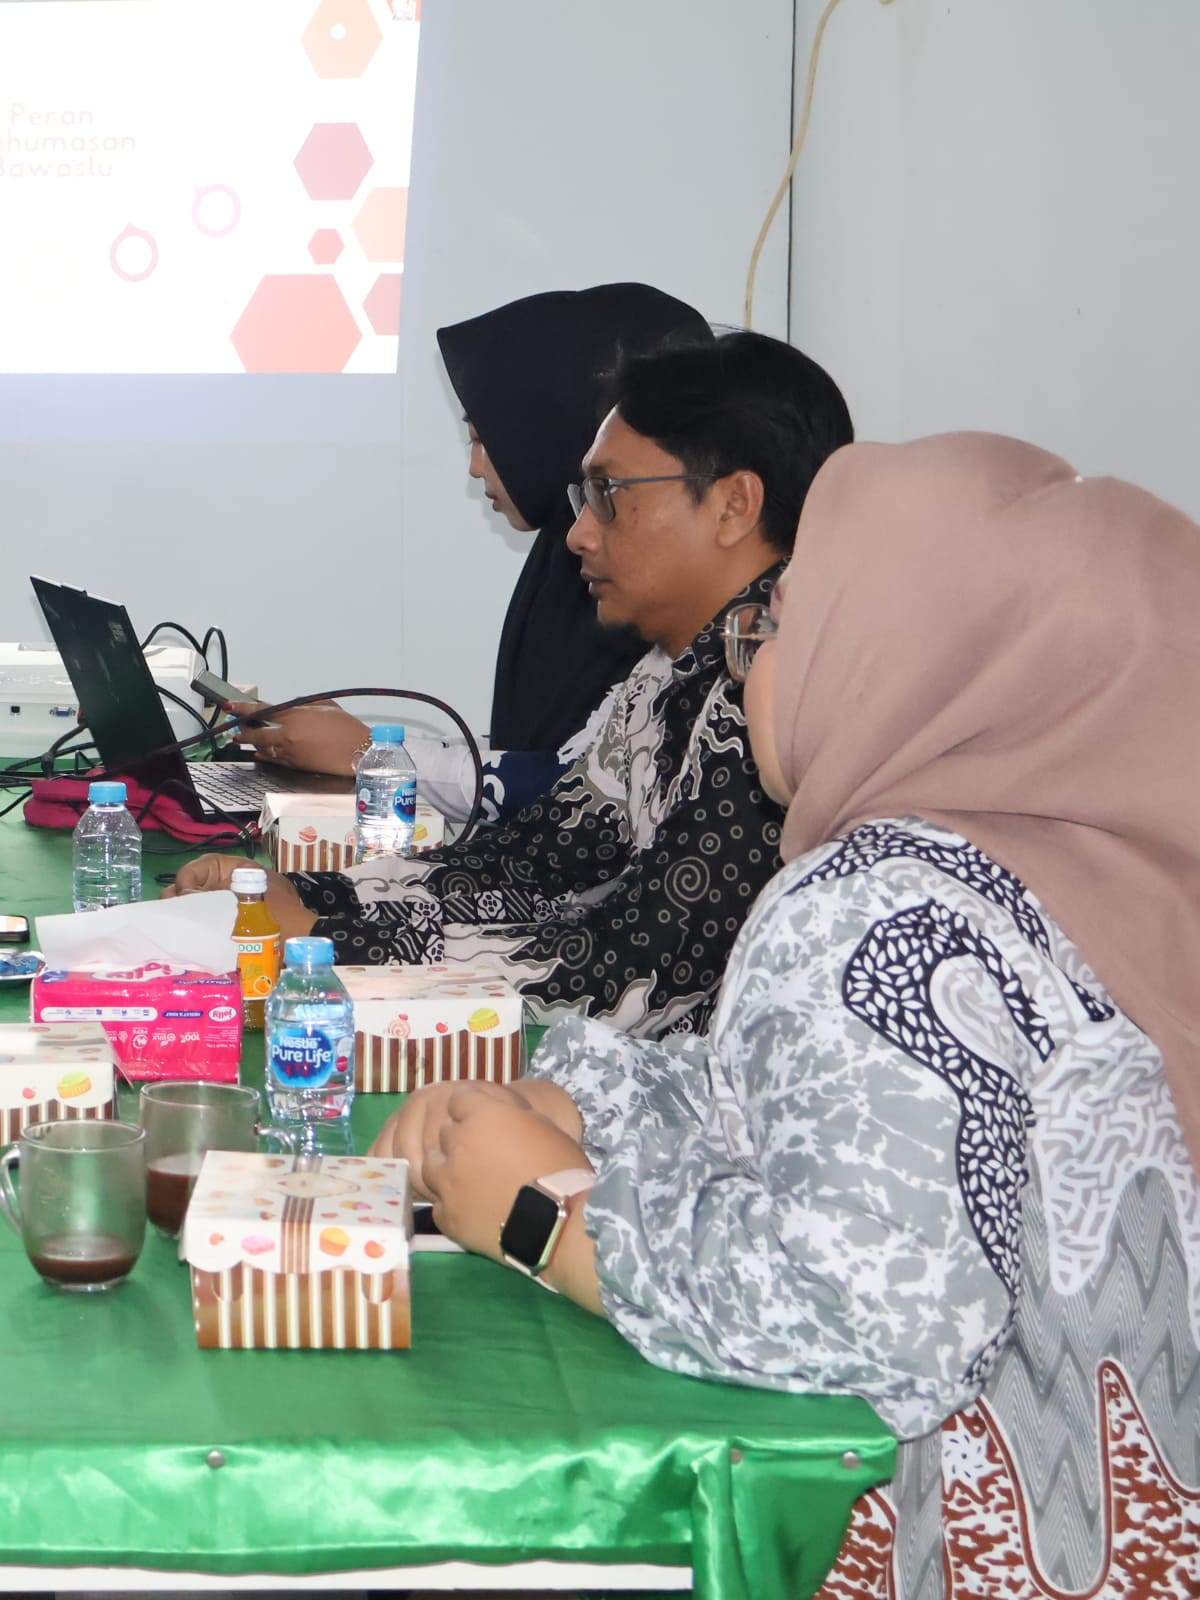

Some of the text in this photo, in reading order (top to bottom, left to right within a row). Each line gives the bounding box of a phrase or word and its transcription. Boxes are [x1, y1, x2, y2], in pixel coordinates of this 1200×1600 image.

[9, 102, 94, 126] Peran
[212, 1008, 233, 1019] jolly
[271, 1044, 332, 1068] Pure Life
